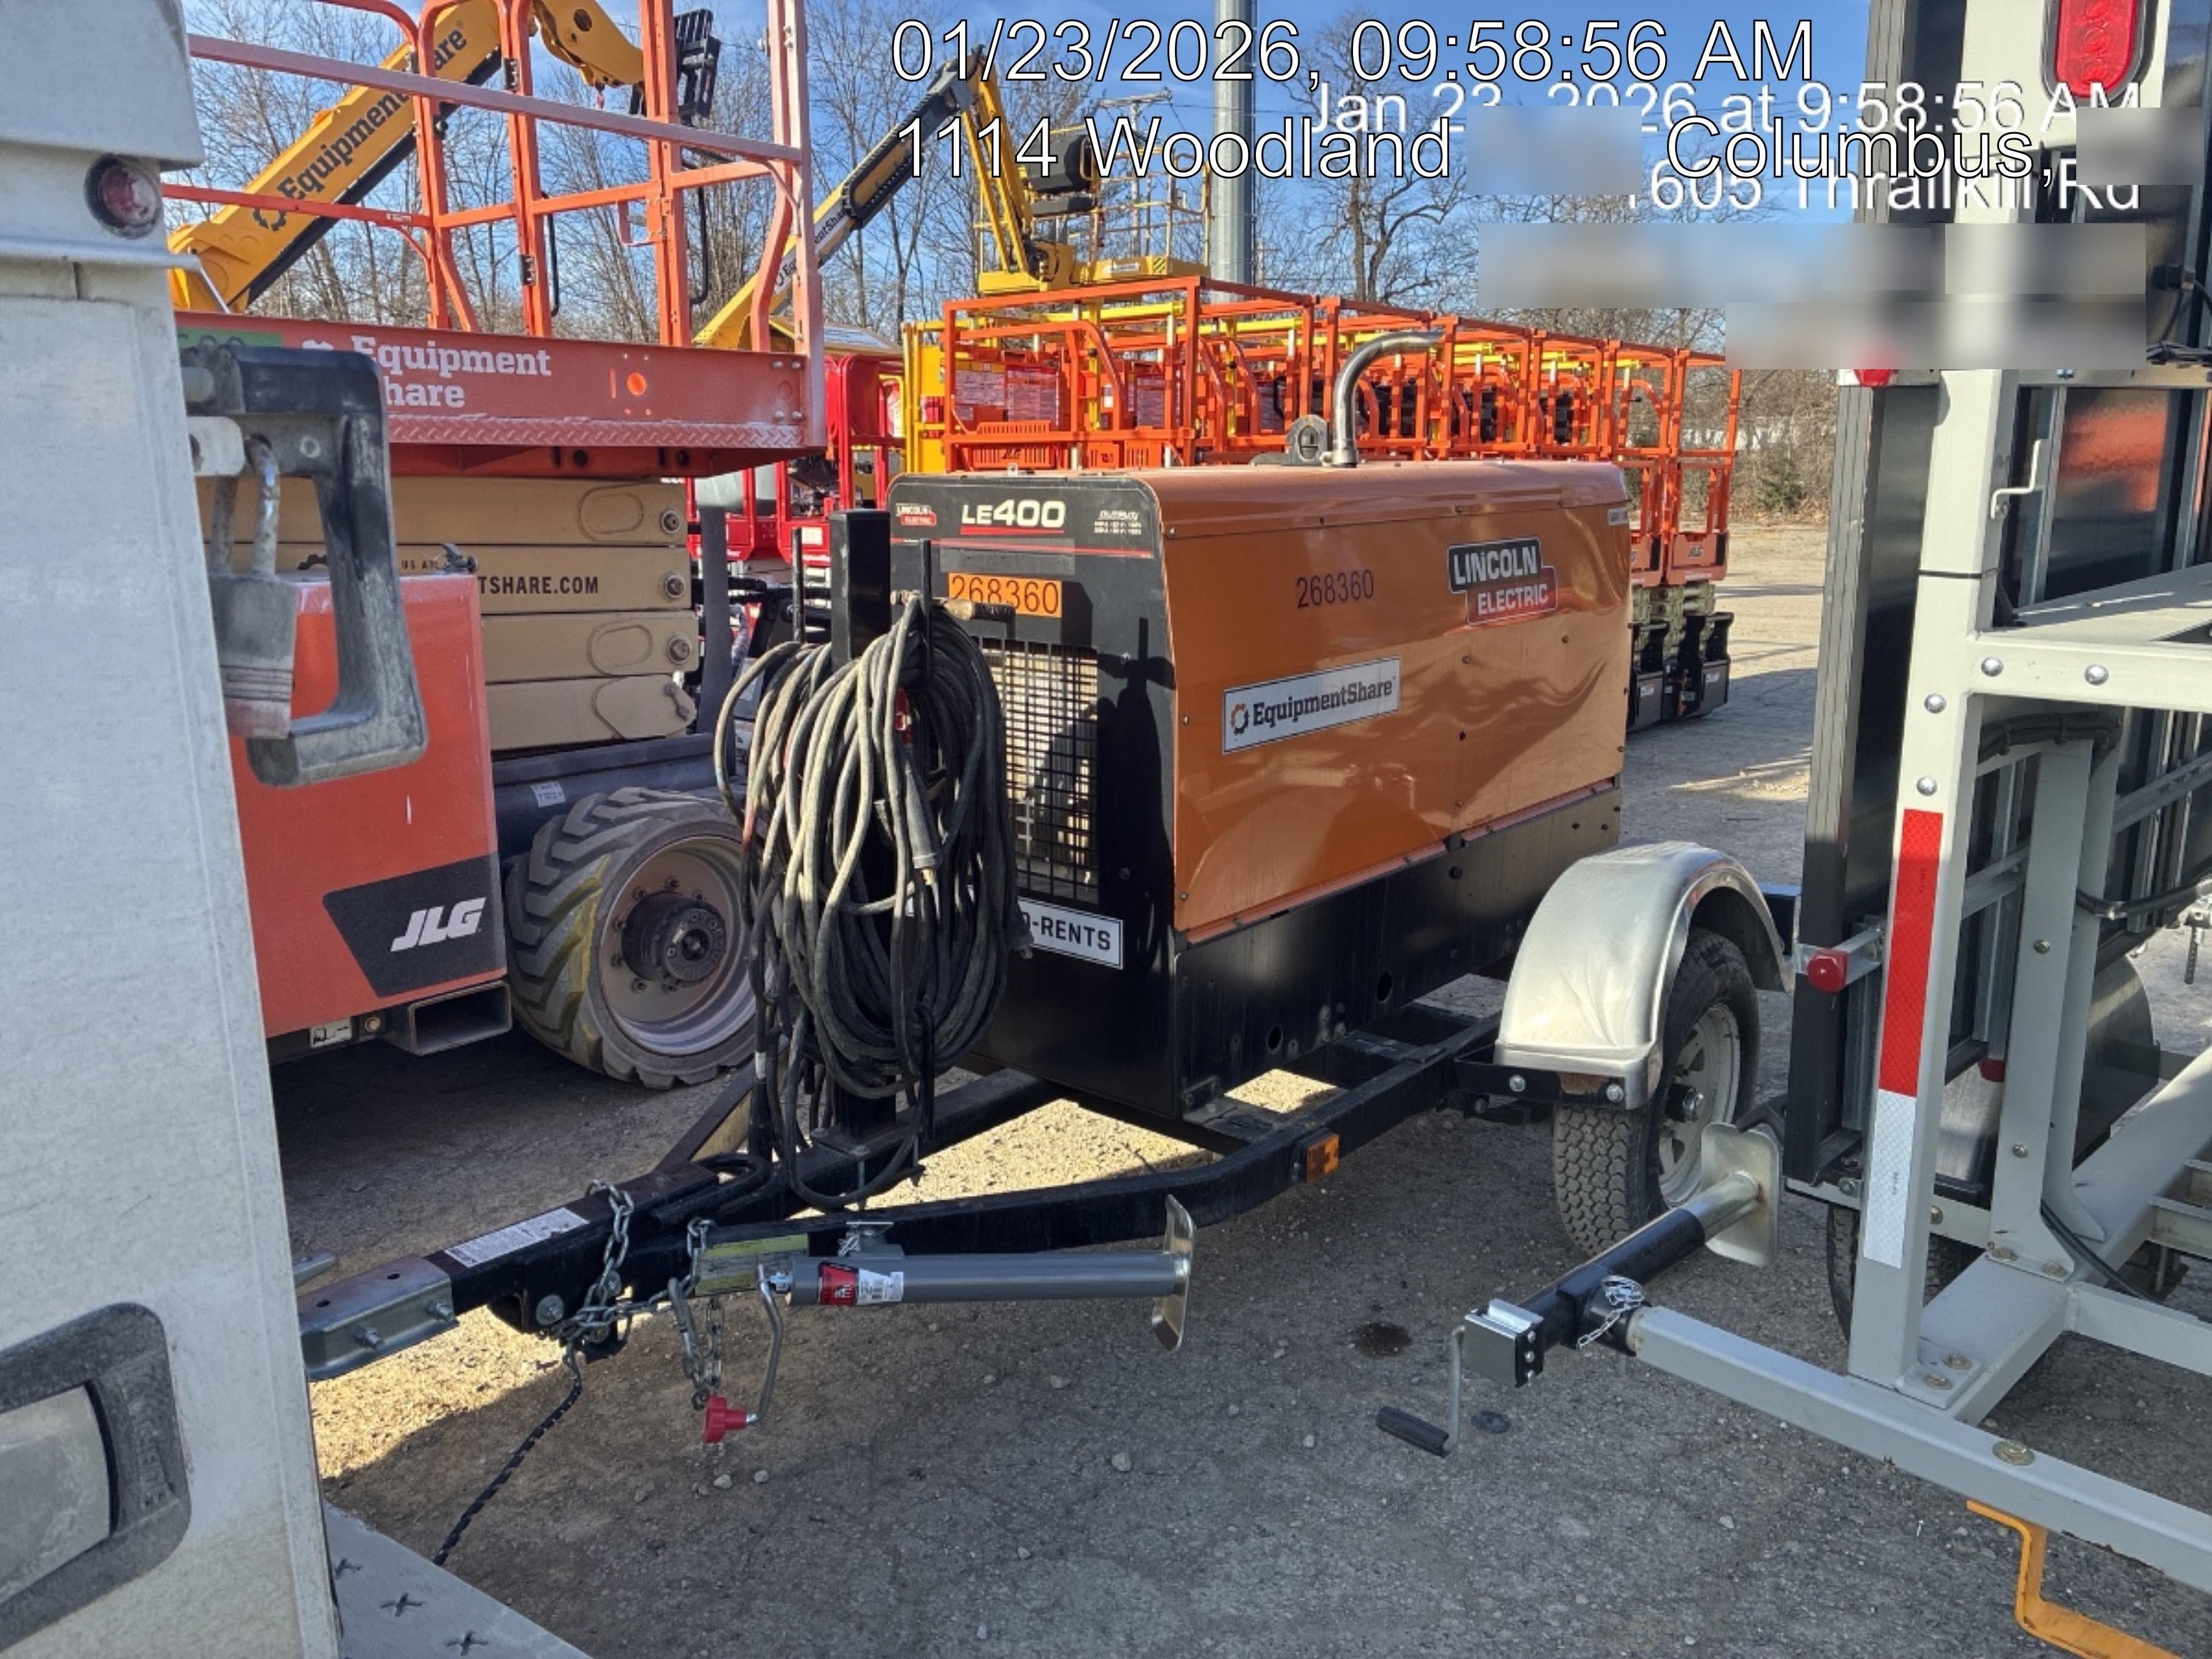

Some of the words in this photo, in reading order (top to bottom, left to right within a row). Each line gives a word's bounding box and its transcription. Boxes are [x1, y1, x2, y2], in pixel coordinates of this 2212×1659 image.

[351, 335, 552, 377] Equipment
[385, 376, 465, 408] hare
[962, 500, 1066, 528] LE400
[402, 560, 415, 570] US
[1454, 545, 1537, 585] LINCOLN
[952, 575, 1059, 614] 268360
[1296, 569, 1375, 609] 268360
[1478, 583, 1548, 616] ELECTRIC
[1253, 679, 1393, 728] EquipmentShare
[390, 896, 487, 952] JLG
